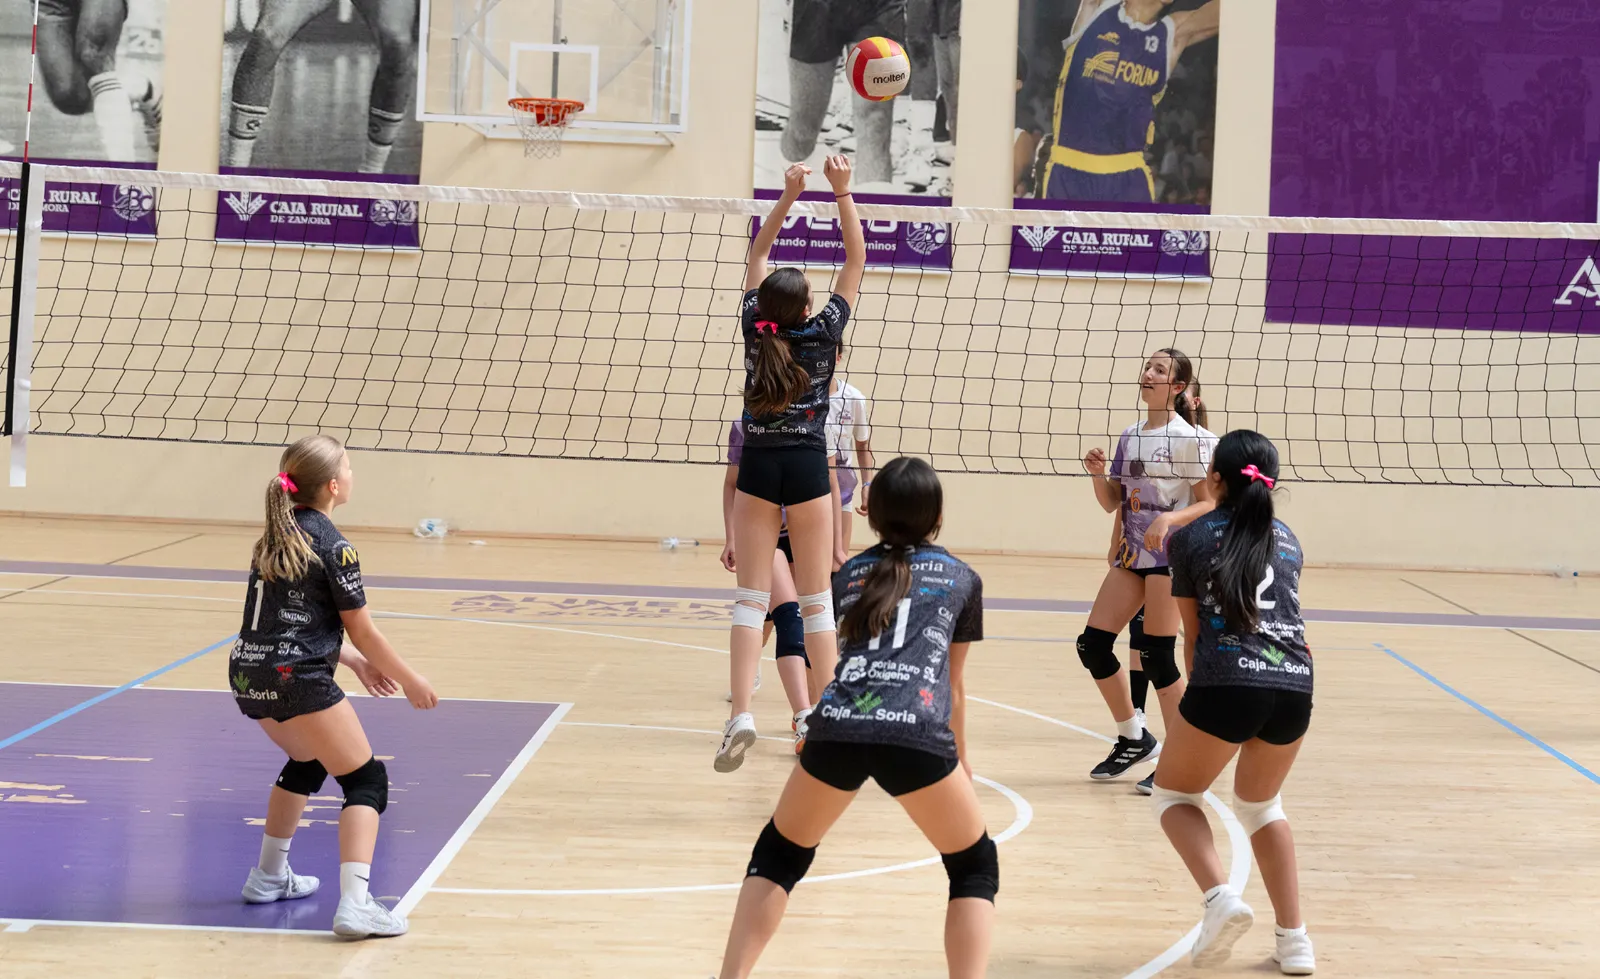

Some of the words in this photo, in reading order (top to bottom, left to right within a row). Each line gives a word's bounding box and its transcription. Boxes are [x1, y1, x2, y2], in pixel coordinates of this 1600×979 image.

[1144, 35, 1159, 53] 13
[873, 72, 905, 84] molten
[1115, 60, 1159, 87] FORUM
[48, 189, 101, 205] RURAL
[42, 203, 69, 213] MORA
[269, 200, 306, 215] CAJA
[311, 202, 363, 217] RURAL
[270, 215, 285, 223] DE
[288, 216, 331, 225] ZAMORA
[773, 237, 807, 248] eando
[1061, 231, 1099, 245] CAJA
[1102, 232, 1153, 247] RURAL
[1062, 244, 1077, 254] DE
[1079, 245, 1122, 255] ZAMORA
[748, 423, 765, 435] Caja
[781, 425, 807, 435] Soria
[1130, 488, 1141, 513] 6
[910, 560, 944, 572] oria
[1256, 563, 1276, 610] 2
[251, 580, 264, 631] 1
[459, 594, 734, 609] ALIMEN
[281, 610, 308, 623] SANTIAGO
[244, 642, 259, 651] Soria
[900, 663, 920, 676] puro
[1238, 657, 1267, 672] Caja
[1284, 662, 1310, 676] Soria
[249, 688, 278, 700] Soria
[821, 704, 851, 721] Caja
[875, 708, 917, 724] Soria
